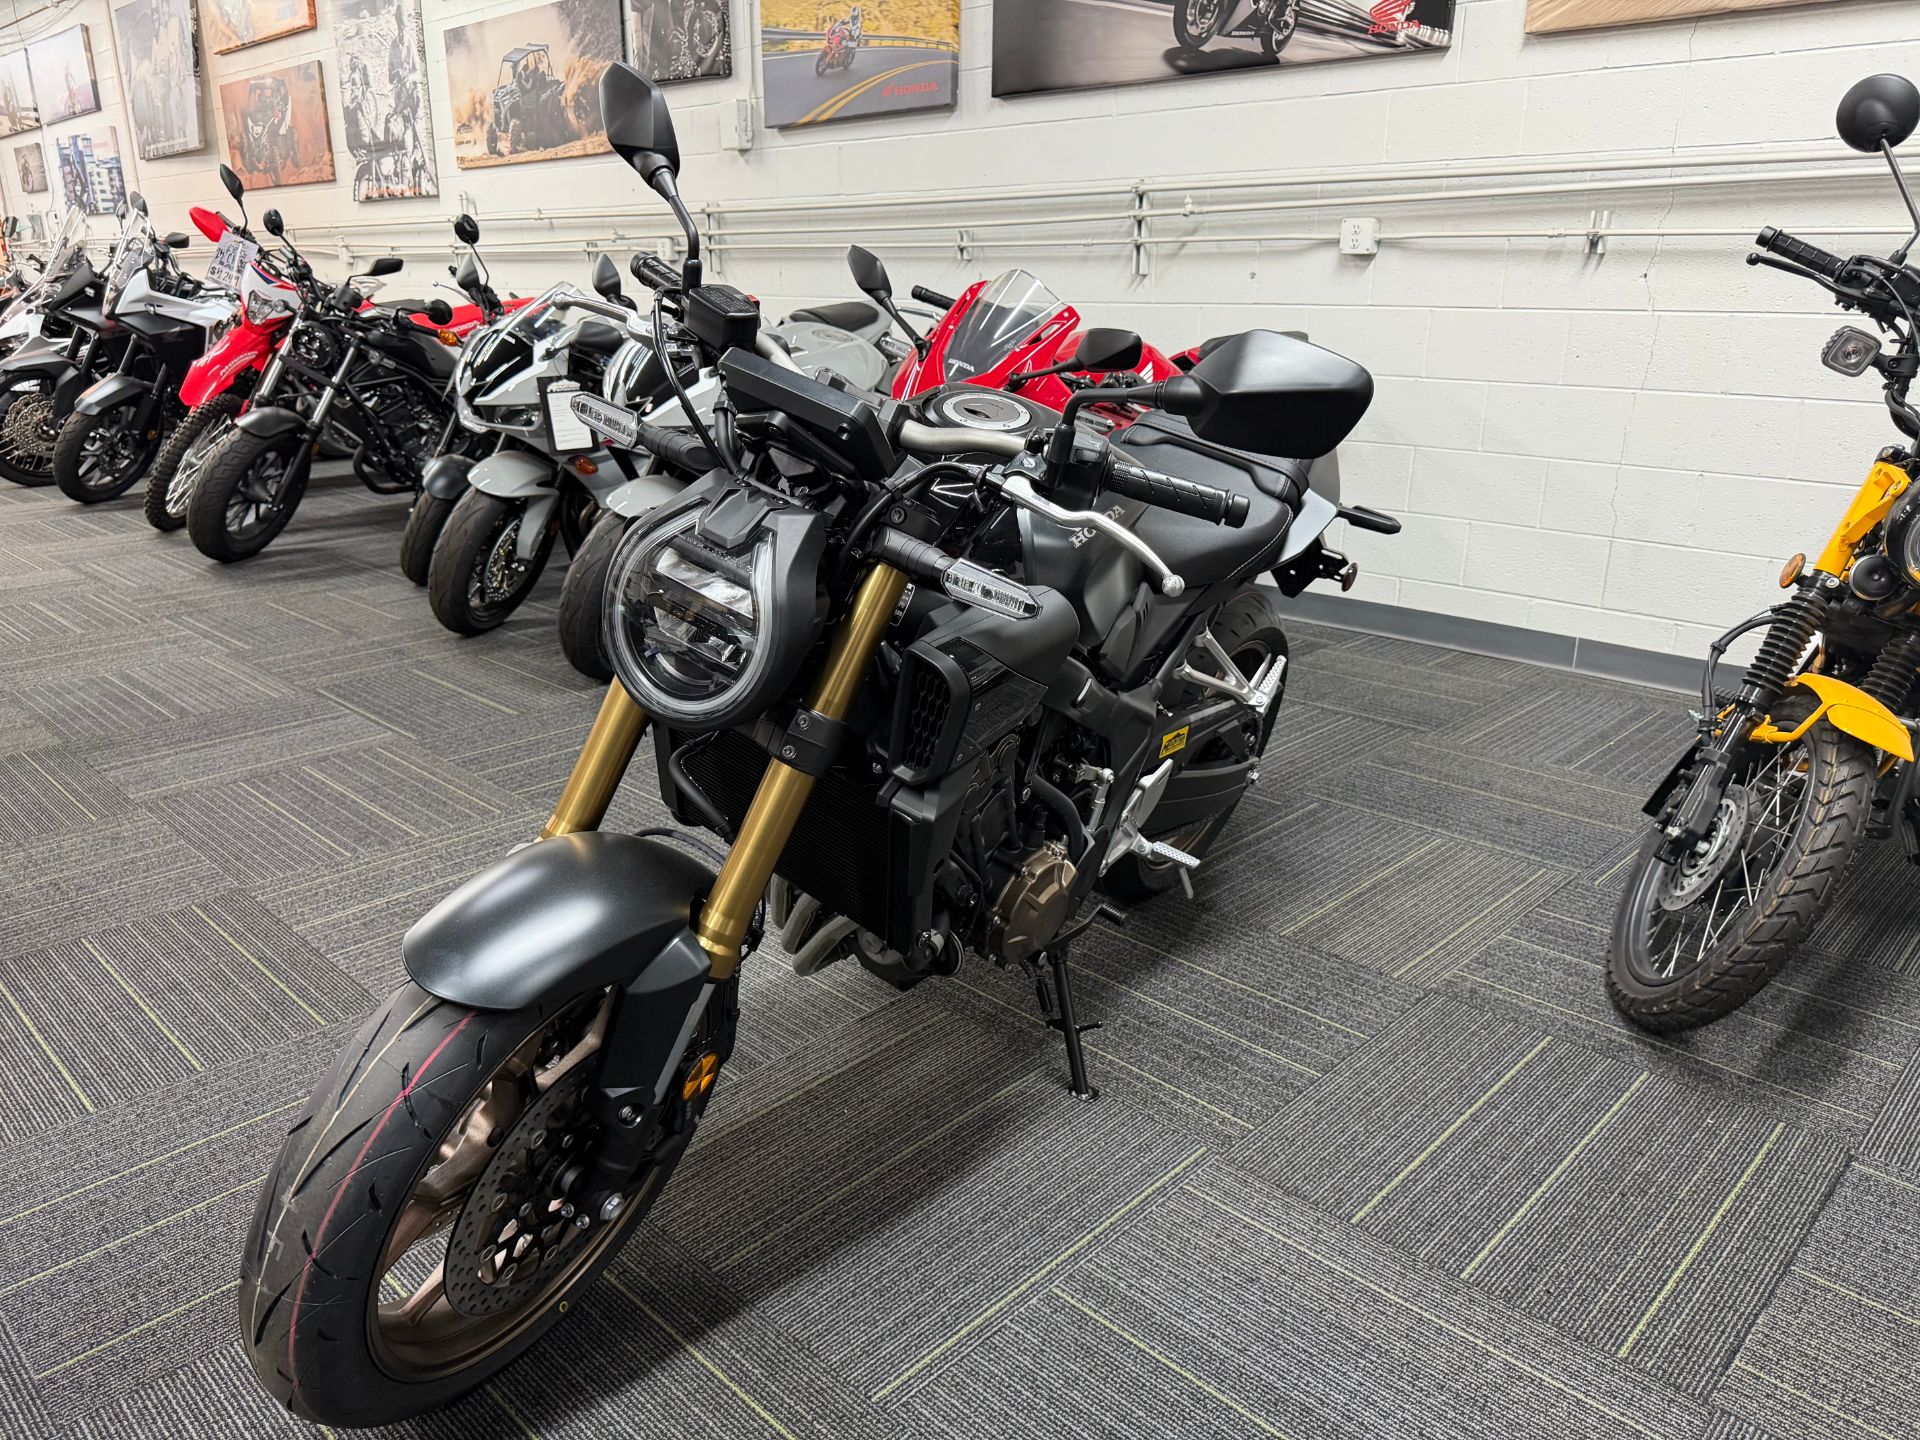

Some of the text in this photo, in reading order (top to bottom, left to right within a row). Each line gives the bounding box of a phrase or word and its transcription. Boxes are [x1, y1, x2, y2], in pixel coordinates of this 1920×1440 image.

[1368, 20, 1421, 34] HONDA
[895, 81, 938, 96] HONDA
[947, 358, 975, 373] HONDA
[1068, 505, 1126, 549] HODA
